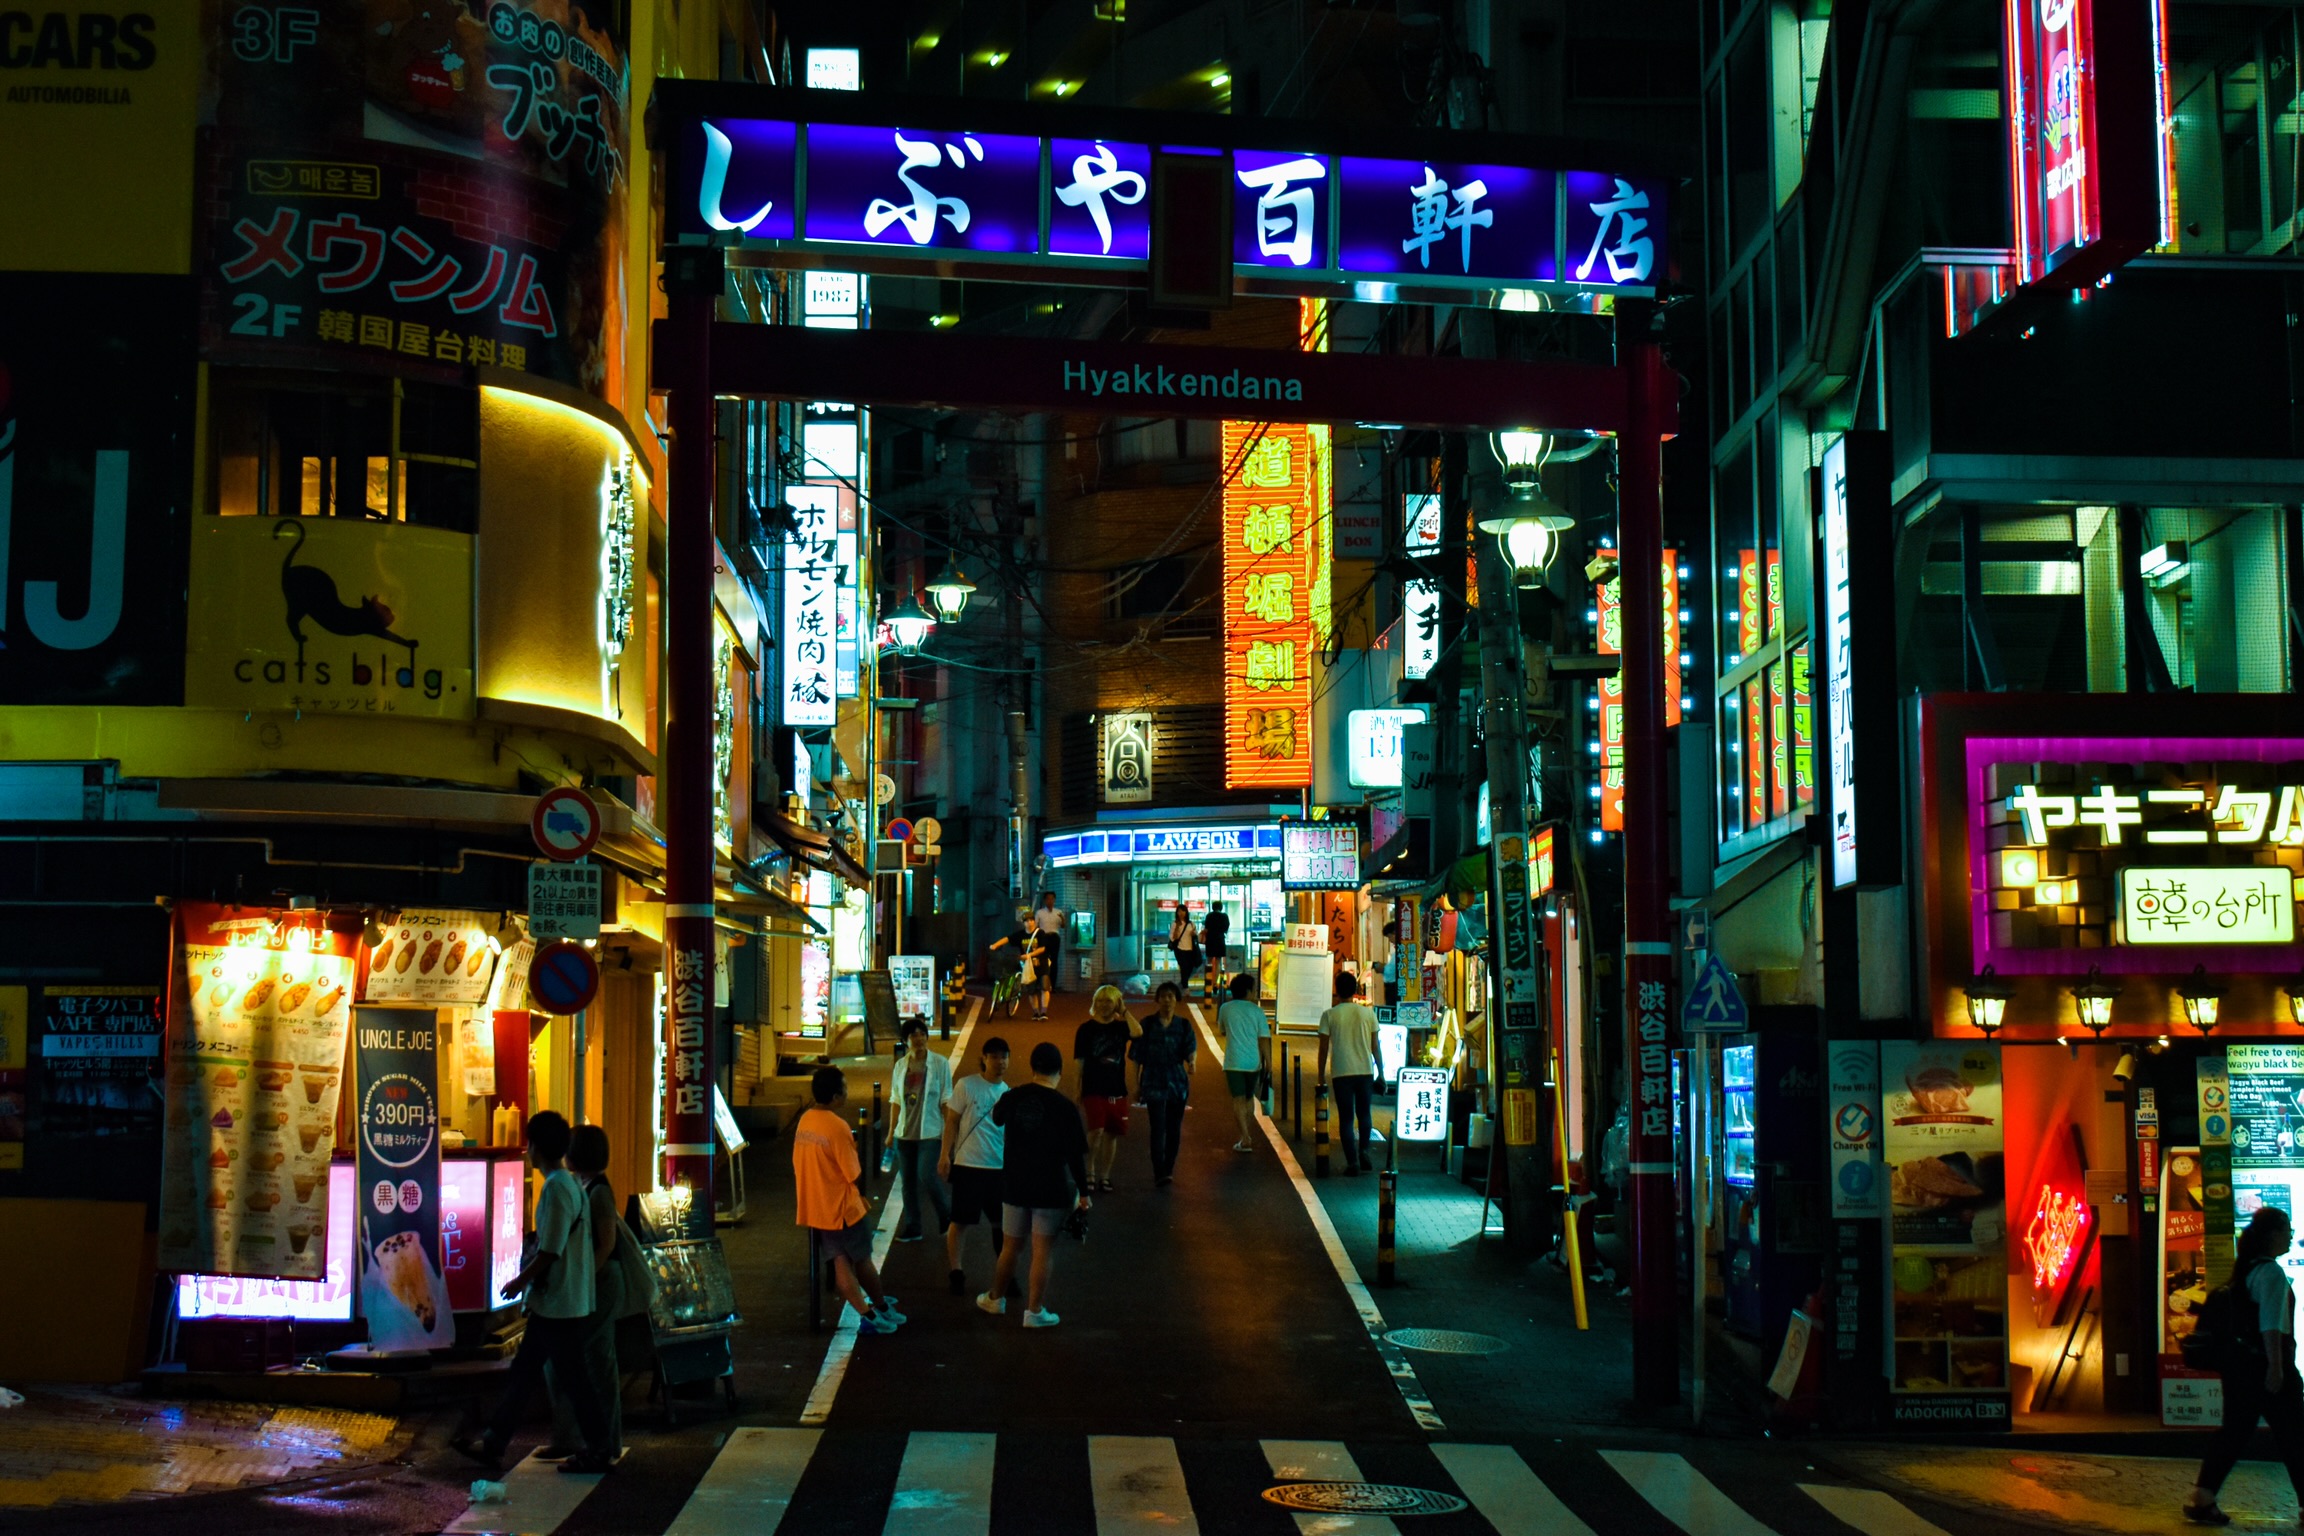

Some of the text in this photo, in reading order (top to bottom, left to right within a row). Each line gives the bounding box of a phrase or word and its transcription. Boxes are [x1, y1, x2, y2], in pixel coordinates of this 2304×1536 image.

[0, 11, 156, 70] CARS
[232, 6, 320, 63] 3F
[490, 5, 565, 58] お肉の
[7, 85, 131, 106] AUTOMOBILIA
[299, 166, 374, 194] 매운놈
[220, 206, 558, 338] メウンノム
[813, 289, 851, 303] 1987
[229, 292, 303, 337] 2F
[317, 307, 528, 372] 韓国屋台料理
[1062, 360, 1303, 402] Hyakkendana
[1335, 517, 1381, 528] LUNCH
[1344, 536, 1373, 547] BOX
[1241, 435, 1297, 760] 道頓堀劇場
[234, 652, 458, 699] cats bldg.
[1410, 751, 1430, 761] Tea
[1147, 831, 1241, 851] LAWSON
[533, 867, 598, 883] 最大積載量
[533, 884, 598, 900] 2t以上の貨物
[532, 902, 598, 918] 居住者用車両
[533, 919, 569, 935] を除く
[1296, 928, 1318, 938] 只今
[1504, 891, 1528, 964] ライオン
[58, 996, 145, 1015] 電子タバコ
[47, 1014, 156, 1033] VAPE 専門店
[675, 950, 705, 1115] 渋谷百軒店
[59, 1036, 144, 1049] VAPE HILLS
[208, 1042, 239, 1052] メニュー
[360, 1028, 433, 1051] UNCLE JOE
[1637, 980, 1669, 1137] 渋谷百軒店
[2228, 1047, 2248, 1057] Feel
[2250, 1047, 2270, 1057] free
[2272, 1048, 2283, 1057] to
[2228, 1060, 2260, 1071] wagyu
[2263, 1059, 2288, 1069] black
[1832, 1083, 1877, 1092] Free Wi-Fi
[375, 1102, 425, 1127] 390円
[373, 1132, 428, 1148] 黒糖ミルクティー
[1833, 1141, 1878, 1152] Charge OK
[376, 1183, 421, 1207] 黒糖
[2170, 1214, 2194, 1225] 明るく
[1894, 1406, 1974, 1420] KADOCHIKA
